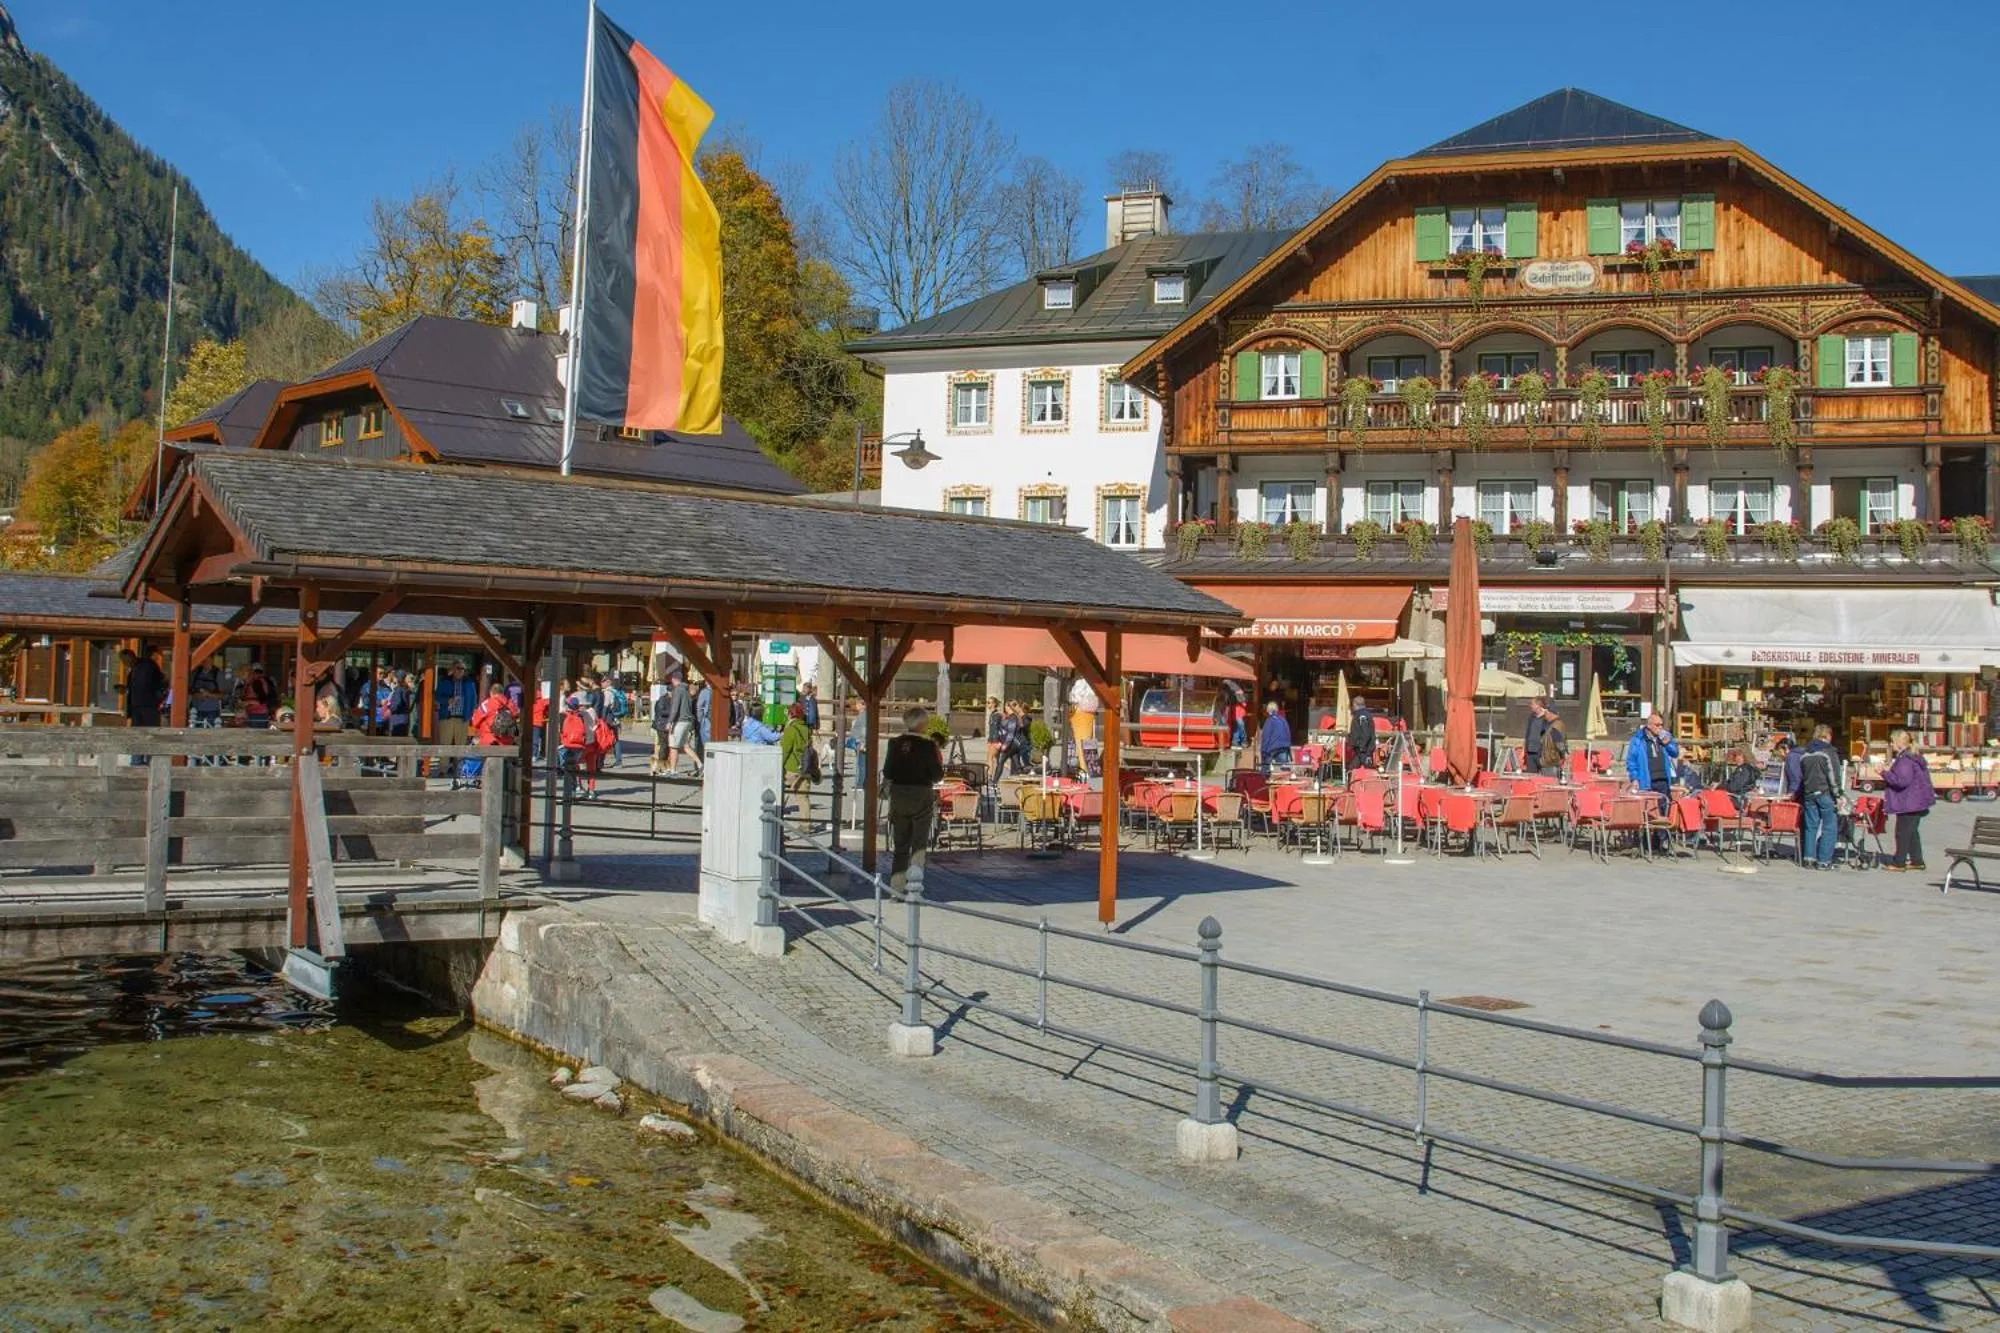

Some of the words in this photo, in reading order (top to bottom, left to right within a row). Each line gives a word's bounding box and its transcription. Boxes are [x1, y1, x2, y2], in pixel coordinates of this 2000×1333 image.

[1263, 624, 1289, 637] SAN
[1293, 624, 1342, 637] MARCO
[1751, 650, 1811, 663] BERGKRISTALLE
[1818, 651, 1865, 664] EDELSTEINE
[1871, 652, 1921, 664] MINERALIEN
